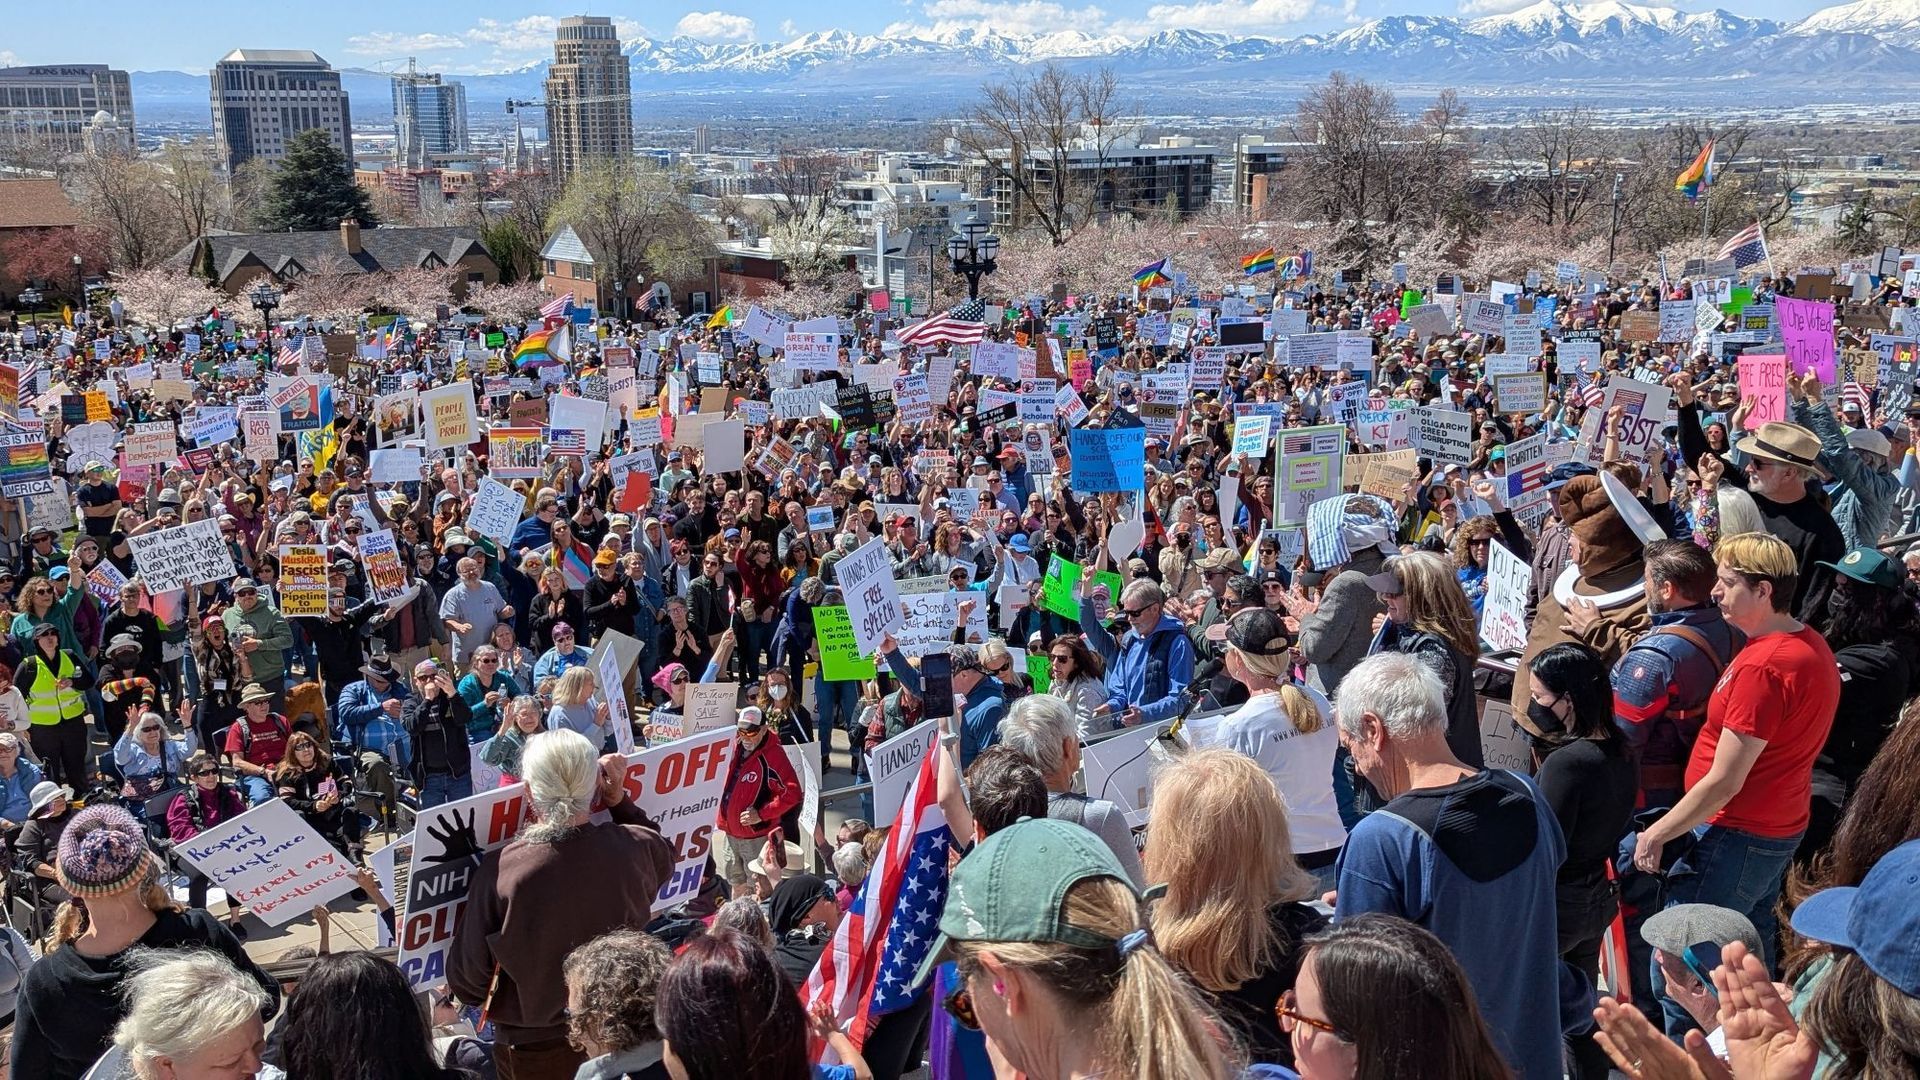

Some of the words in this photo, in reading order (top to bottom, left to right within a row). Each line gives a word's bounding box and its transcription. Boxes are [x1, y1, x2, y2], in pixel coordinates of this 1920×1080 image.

[60, 68, 86, 76] BANK
[1481, 308, 1503, 318] OFF!
[1787, 302, 1804, 331] One
[1806, 304, 1832, 332] Voted
[1873, 341, 1893, 351] GET
[1798, 340, 1827, 366] This!
[609, 376, 634, 394] RESIST
[904, 375, 925, 383] HANDS
[273, 378, 308, 406] IMPEACH
[837, 388, 856, 399] HANDS
[857, 384, 868, 396] OFF
[1342, 382, 1366, 392] HANDS
[1347, 389, 1362, 397] OFF!
[774, 390, 818, 406] DEMOCRACY
[878, 390, 892, 400] OFF
[897, 388, 928, 399] SCHOOL
[435, 403, 463, 416] PEOPLE
[782, 405, 811, 418] NOW
[899, 401, 931, 413] SUMMER
[1064, 398, 1082, 417] UTAH
[1153, 408, 1174, 416] FDIC
[1410, 408, 1432, 417] STOP
[901, 409, 933, 421] LUNCHES
[977, 413, 988, 422] WE
[989, 407, 1004, 418] THE
[979, 414, 1006, 427] PEOPLE
[136, 422, 174, 432] IMPEACH
[249, 420, 269, 428] DATA
[282, 420, 318, 428] TRAITOR
[1240, 421, 1264, 429] Utahns
[1421, 418, 1468, 432] OLIGARCHY
[250, 427, 270, 436] NOT
[439, 423, 467, 438] PROFIT
[1240, 427, 1264, 436] Against
[1421, 426, 1447, 437] GREED
[12, 435, 22, 444] IS
[24, 432, 42, 444] MY
[1075, 432, 1106, 446] HANDS
[1110, 431, 1127, 442] OFF
[1128, 431, 1143, 441] OUR
[1238, 434, 1262, 444] Power
[1421, 433, 1470, 448] CORRUPTION
[1237, 442, 1261, 453] Grabs
[128, 450, 173, 461] DEMOCRACY
[1421, 448, 1469, 463] DISFUNCTION
[1506, 444, 1543, 467] REWRITTEN
[494, 456, 507, 468] BE
[613, 463, 626, 474] ONLY
[641, 458, 652, 468] YOU
[1030, 459, 1050, 471] RICH
[4, 481, 52, 496] AMERICA
[616, 478, 625, 487] CAN
[1077, 478, 1099, 489] BACK
[1298, 489, 1315, 502] 86
[1369, 483, 1396, 497] GREAT
[472, 489, 494, 528] HANDS
[54, 516, 70, 526] OFF
[360, 538, 394, 551] DEMOCRACY
[366, 535, 384, 544] Save
[135, 541, 194, 563] Teachers
[193, 532, 222, 551] Just
[290, 547, 316, 555] Tesla
[365, 546, 393, 556] Stop
[140, 561, 165, 574] Lost
[165, 552, 196, 567] Their
[282, 556, 325, 564] MuskRAT
[1492, 543, 1506, 574] YOU
[195, 558, 225, 574] Fight
[282, 565, 326, 576] Fascist
[841, 562, 866, 590] HANDS
[866, 551, 877, 573] OFF
[109, 568, 124, 585] Save
[294, 575, 314, 584] White
[90, 582, 119, 597] STOP
[150, 582, 170, 594] For
[282, 590, 327, 602] Pipeline
[372, 587, 405, 602] Fascist
[863, 582, 884, 611] FREE
[282, 606, 326, 614] Tyranny
[913, 596, 951, 616] Some
[820, 610, 832, 618] NO
[863, 600, 896, 641] SPEECH
[944, 619, 954, 630] go
[825, 644, 838, 652] NO
[712, 689, 736, 700] Trump
[654, 713, 680, 722] HANDS
[694, 707, 720, 718] SAVE
[880, 740, 922, 778] HANDS
[654, 738, 731, 796] OFF
[651, 814, 669, 826] of
[670, 796, 719, 819] Health
[187, 825, 258, 863] Respect
[235, 836, 267, 854] my
[212, 835, 305, 883] Existence
[266, 862, 282, 873] OR
[236, 868, 302, 904] Expect
[305, 852, 334, 870] my
